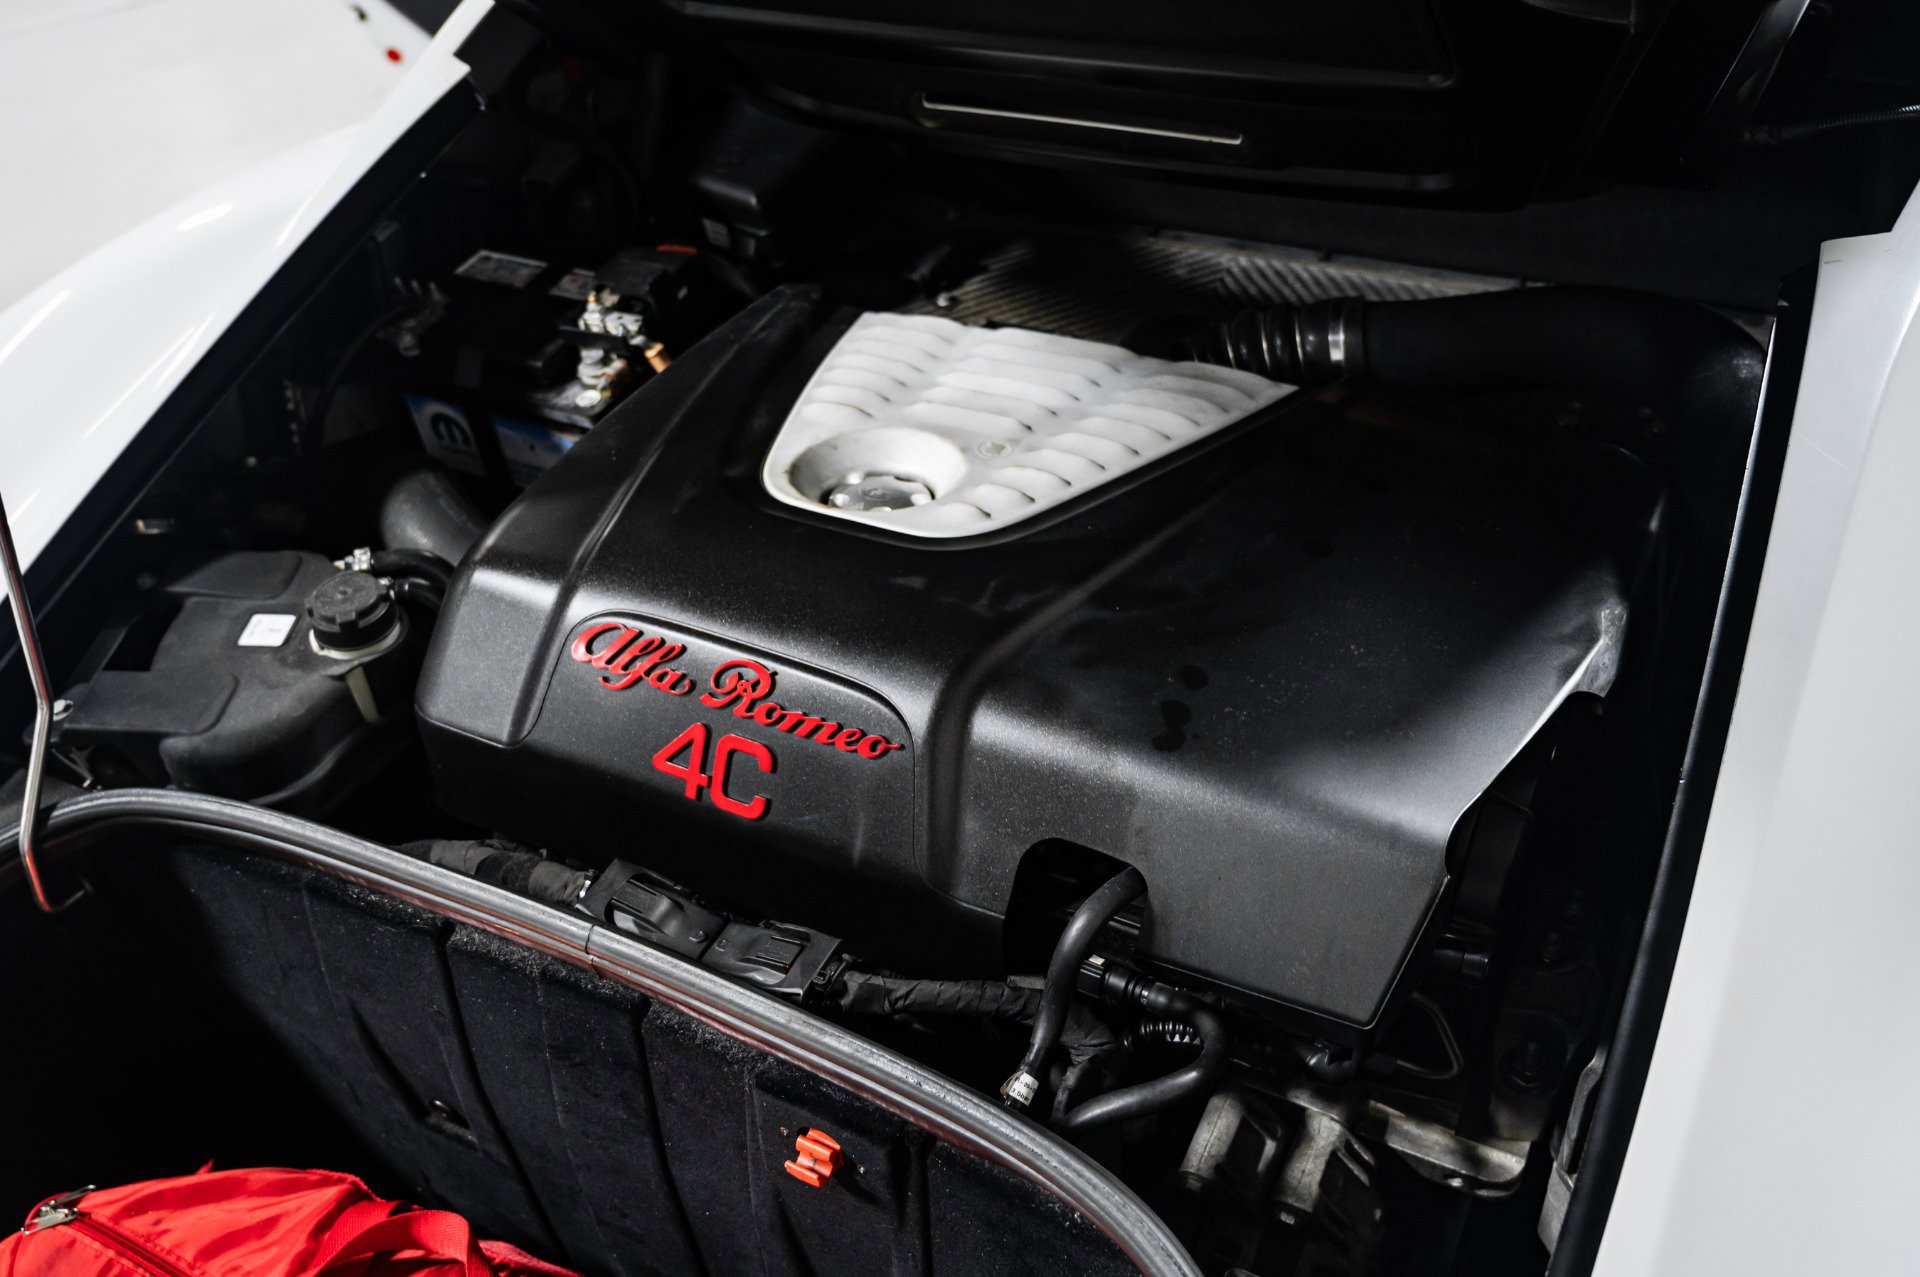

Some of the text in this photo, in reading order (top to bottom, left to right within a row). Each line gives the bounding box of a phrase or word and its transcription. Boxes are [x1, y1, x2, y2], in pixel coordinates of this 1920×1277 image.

[571, 623, 903, 759] Alfa Romeo
[652, 722, 774, 821] 4C
